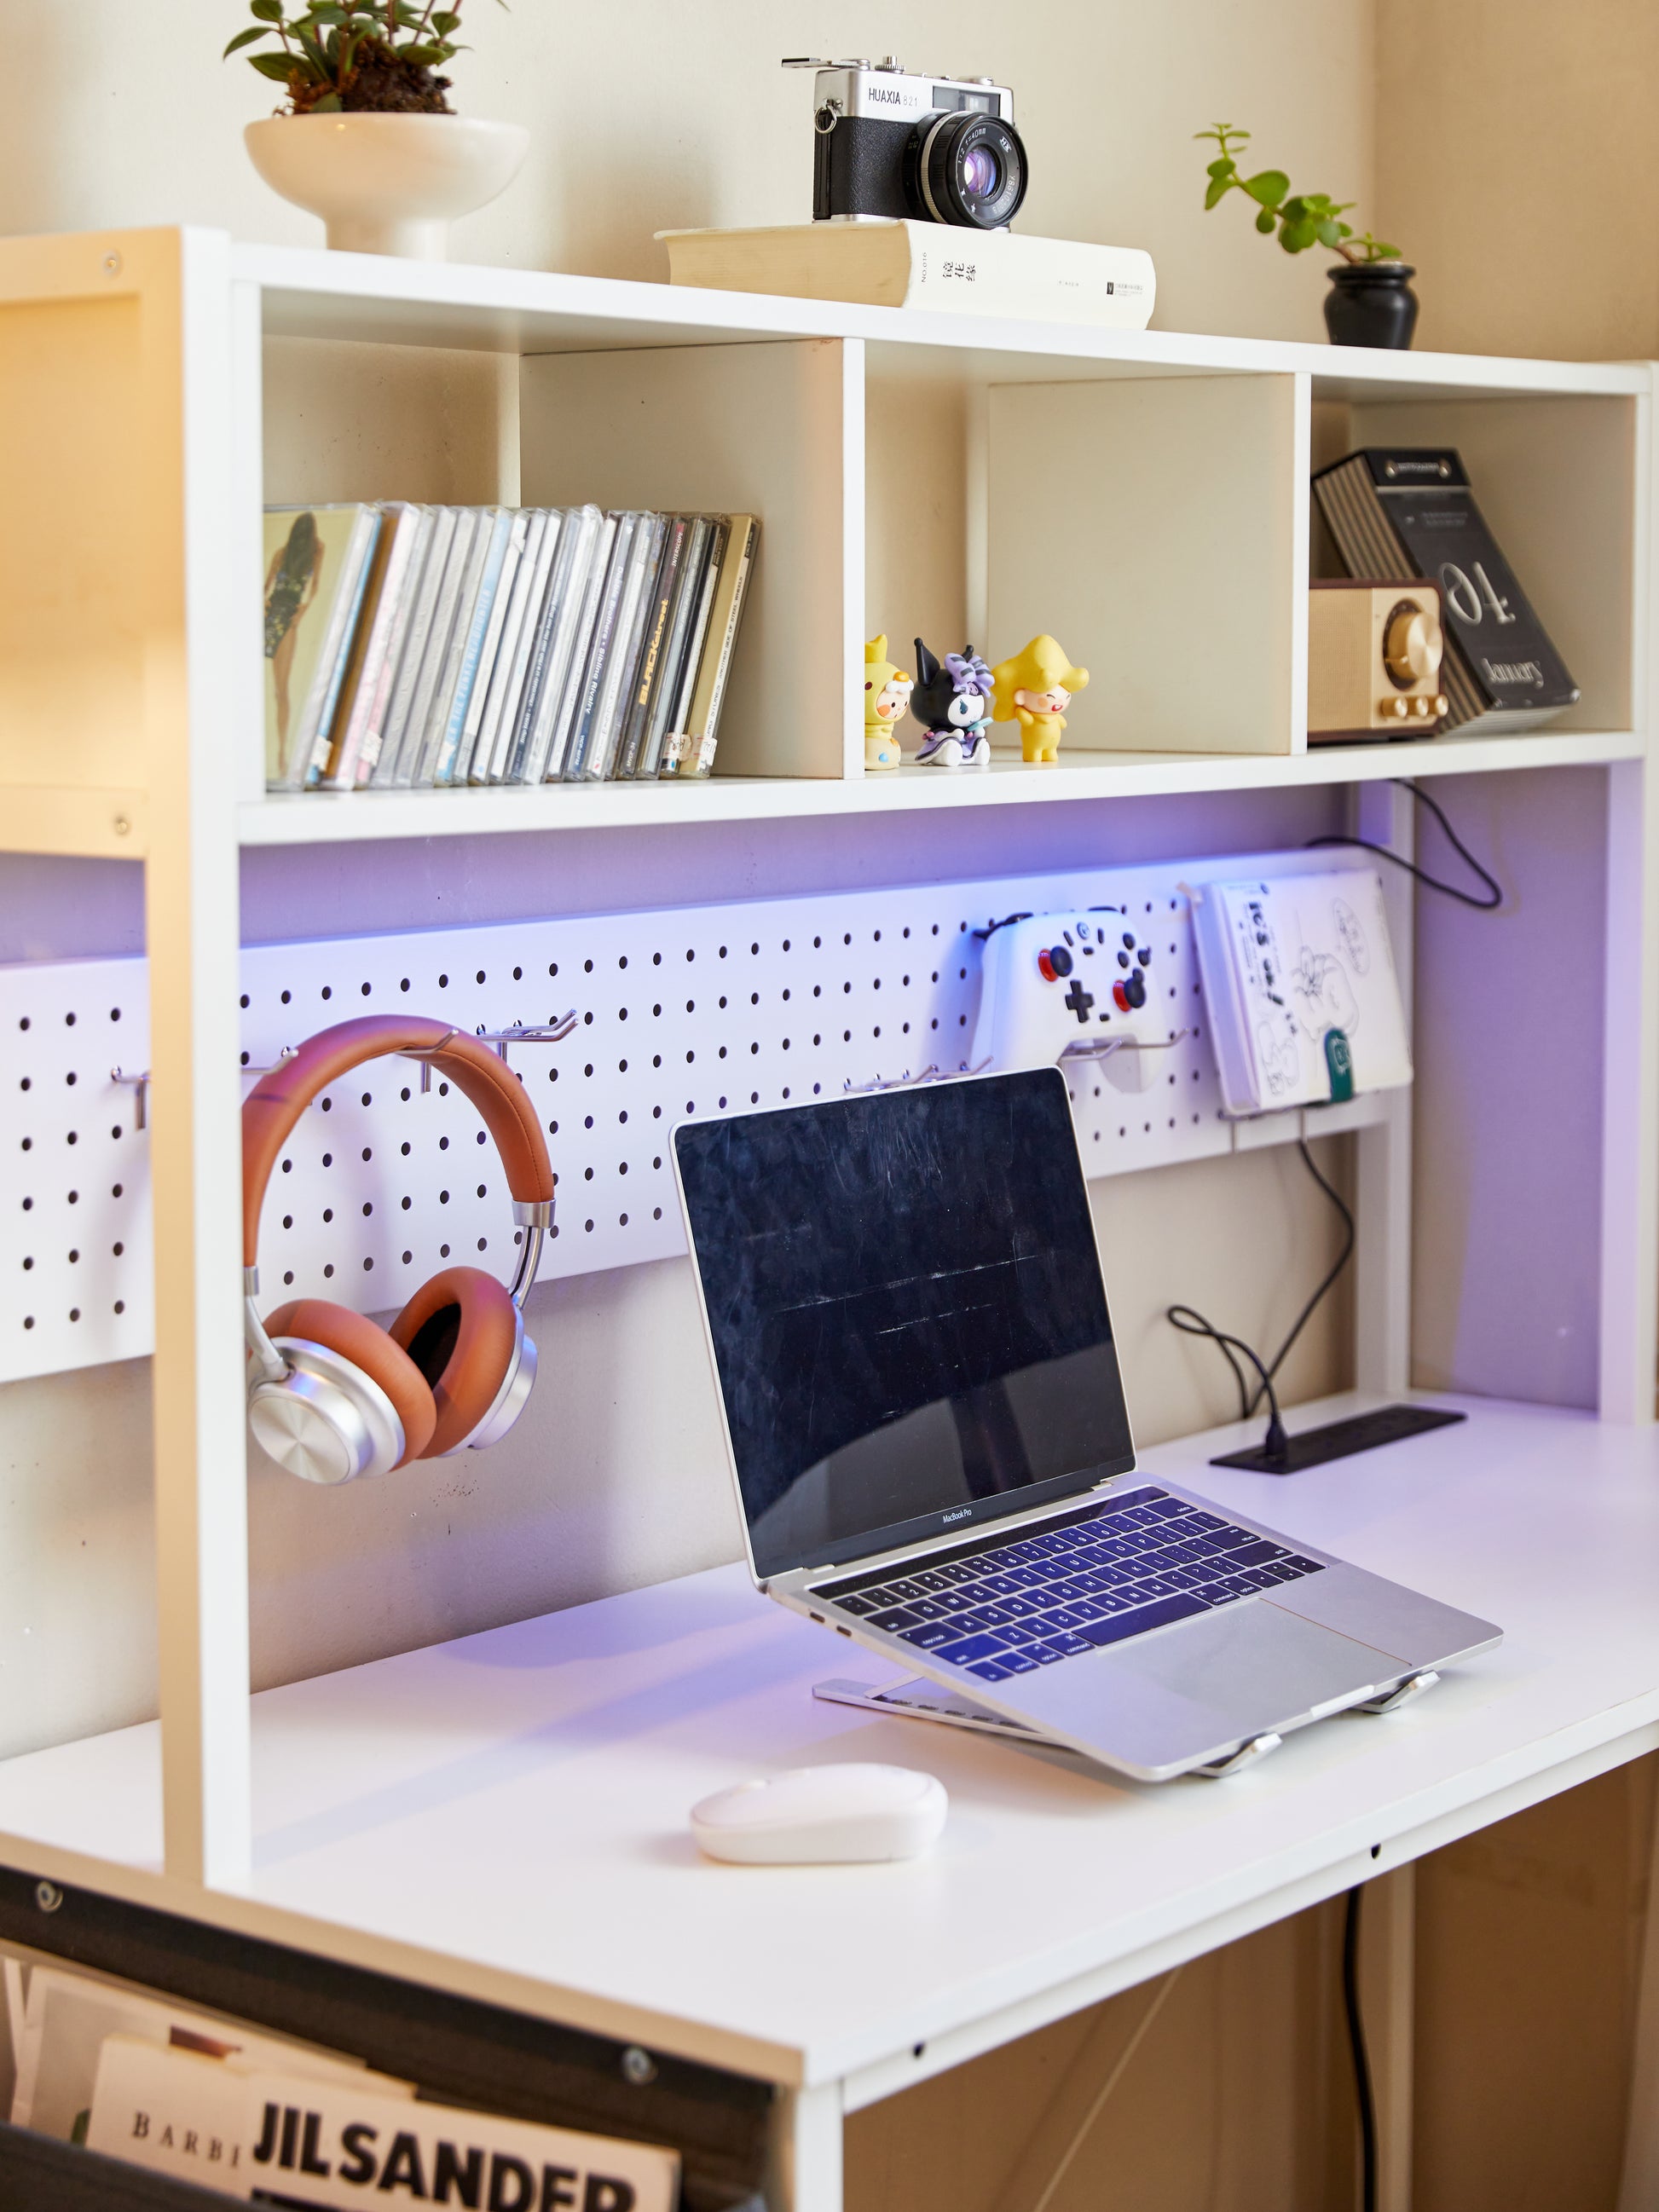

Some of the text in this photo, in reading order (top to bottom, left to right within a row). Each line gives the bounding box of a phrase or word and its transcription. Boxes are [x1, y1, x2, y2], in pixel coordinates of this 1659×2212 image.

[868, 87, 917, 107] HUAXIA 821
[672, 531, 684, 566] INTERSCOPE
[604, 599, 617, 639] Brothers
[594, 647, 606, 679] Sibling
[587, 680, 598, 714] Rivalry
[942, 1509, 973, 1523] MacBook Pro
[131, 2111, 240, 2169] BARBI
